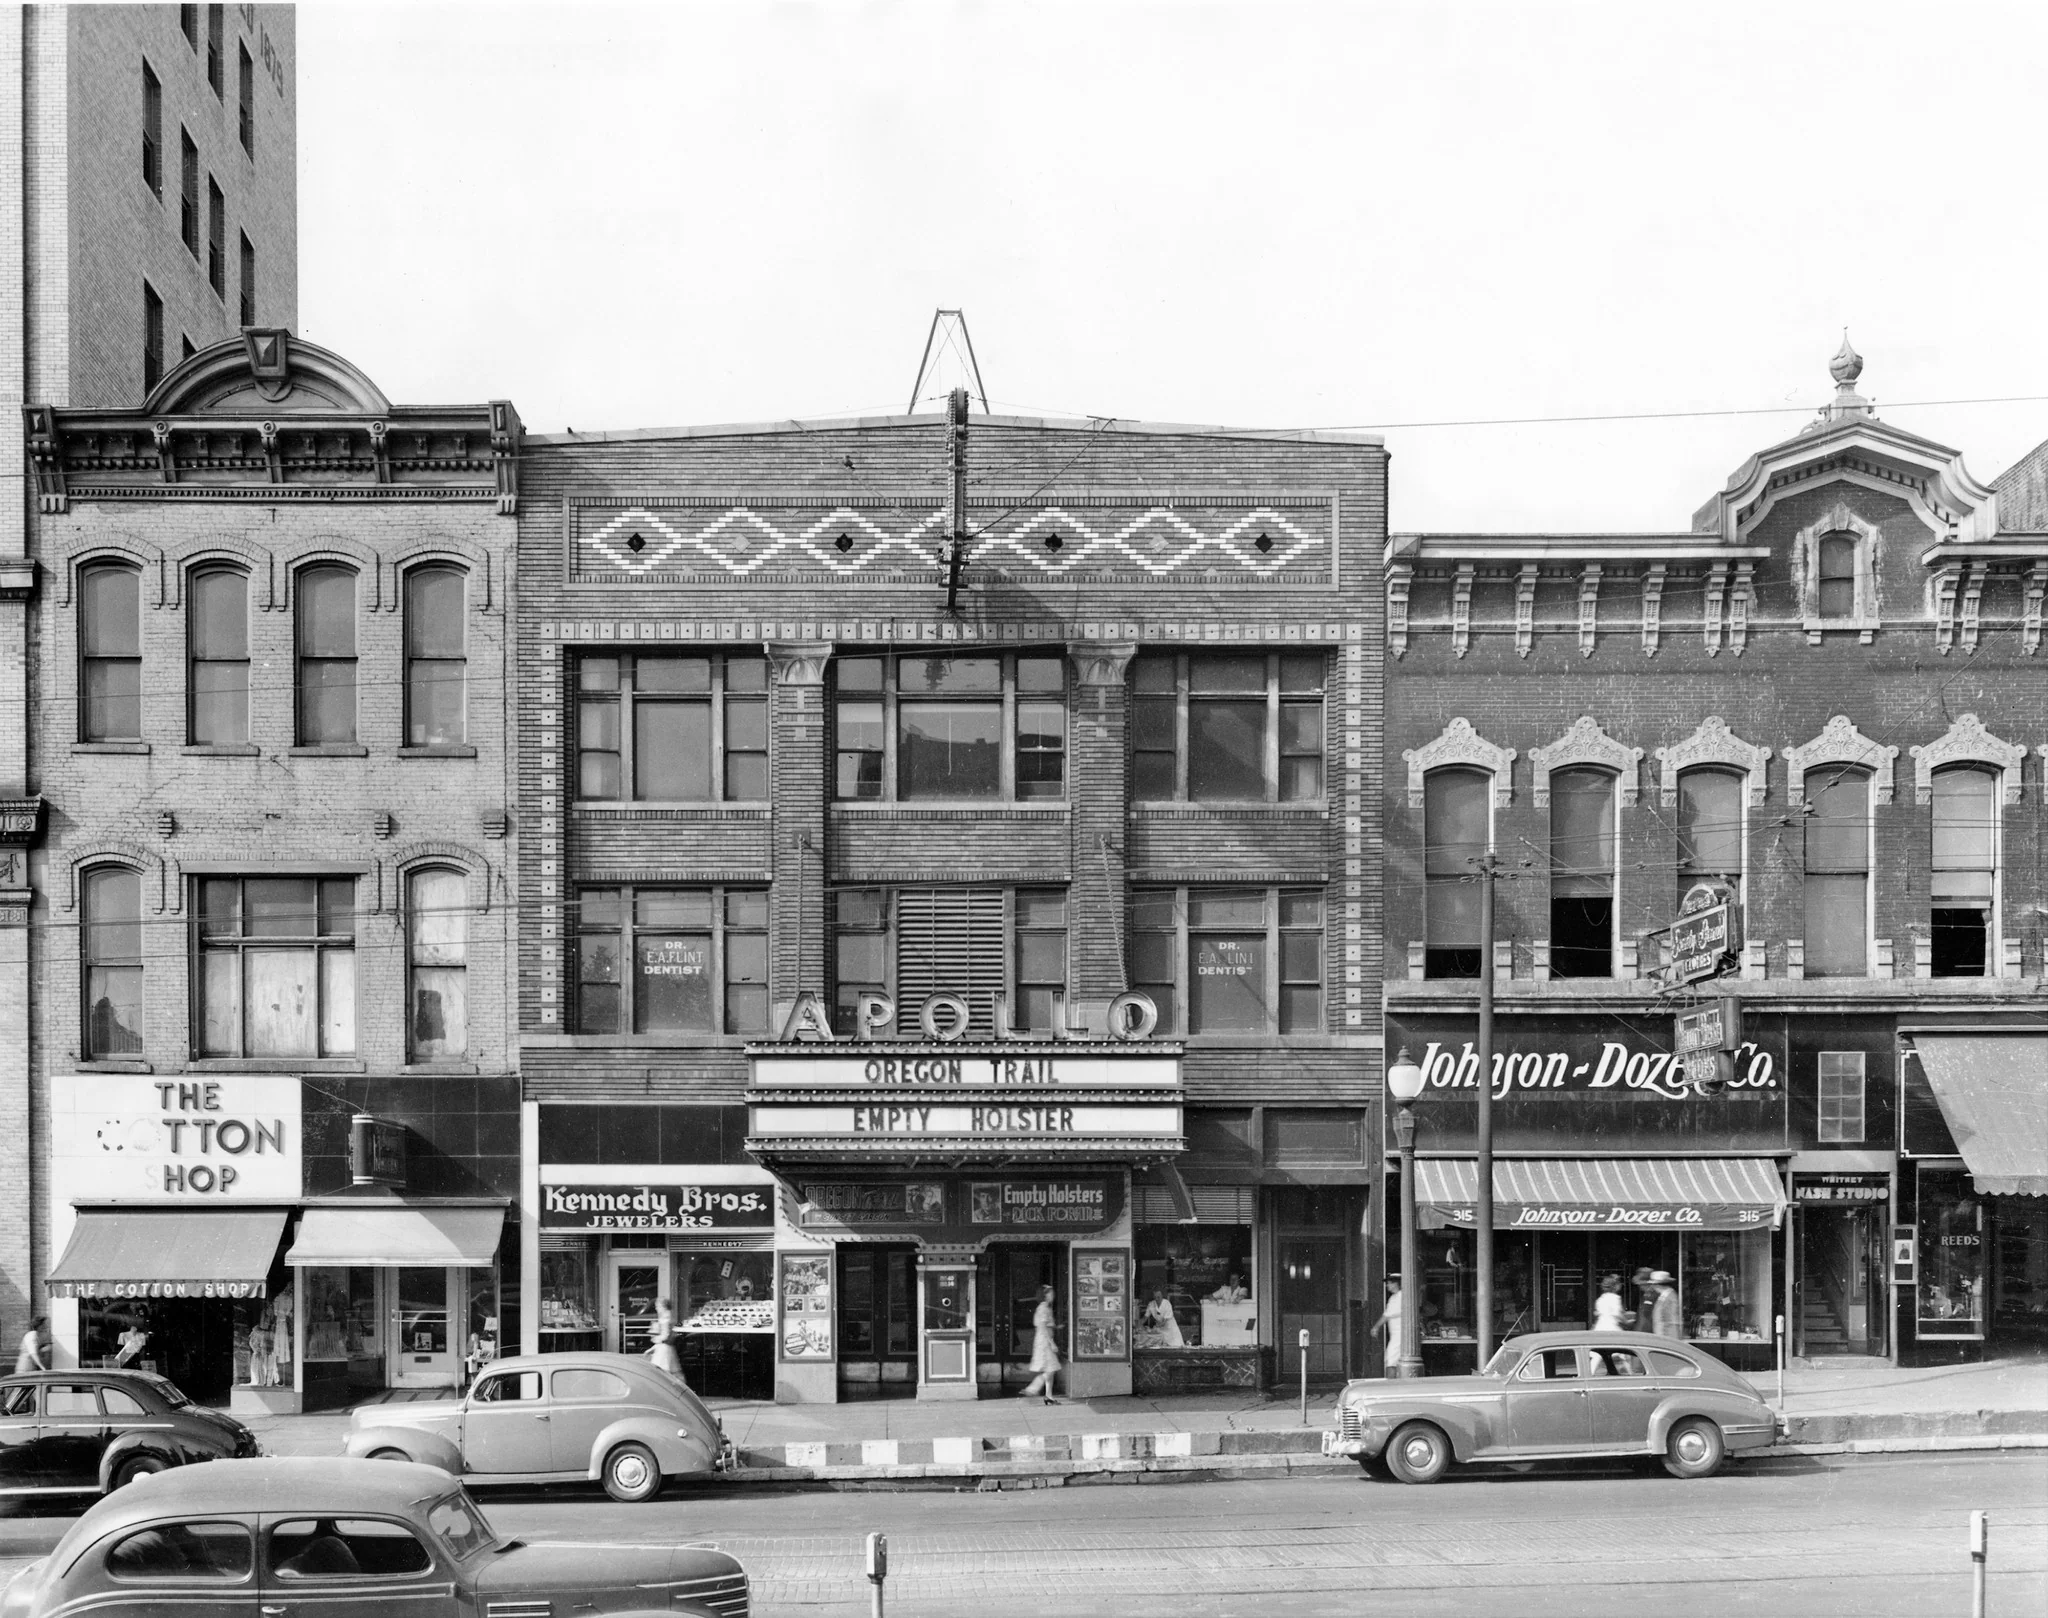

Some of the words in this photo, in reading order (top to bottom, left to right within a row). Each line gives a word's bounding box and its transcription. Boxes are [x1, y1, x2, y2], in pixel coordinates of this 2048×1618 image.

[665, 941, 687, 950] DR.
[1218, 942, 1241, 950] DR.
[644, 966, 703, 975] DENTIST
[780, 990, 1158, 1041] APOLLO
[864, 1060, 962, 1083] OREGON
[990, 1060, 1059, 1083] TRAIL
[1414, 1042, 1712, 1100] Johnson-Doze
[154, 1082, 220, 1110] THE
[853, 1107, 931, 1131] EMPTY
[971, 1107, 1074, 1131] HOLSTER
[1004, 1184, 1047, 1207] Empty
[1049, 1184, 1104, 1204] Holsters
[1795, 1187, 1832, 1200] NASH
[1836, 1187, 1889, 1200] STUDIO
[544, 1186, 669, 1217] Kennedy
[678, 1186, 768, 1216] Bros.
[586, 1215, 714, 1228] JEWELERS
[1453, 1209, 1473, 1222] 315
[1675, 1207, 1703, 1223] Co.
[1738, 1209, 1760, 1223] 315
[64, 1283, 95, 1296] THE
[115, 1283, 186, 1296] COTTON
[204, 1283, 250, 1296] SHOP
